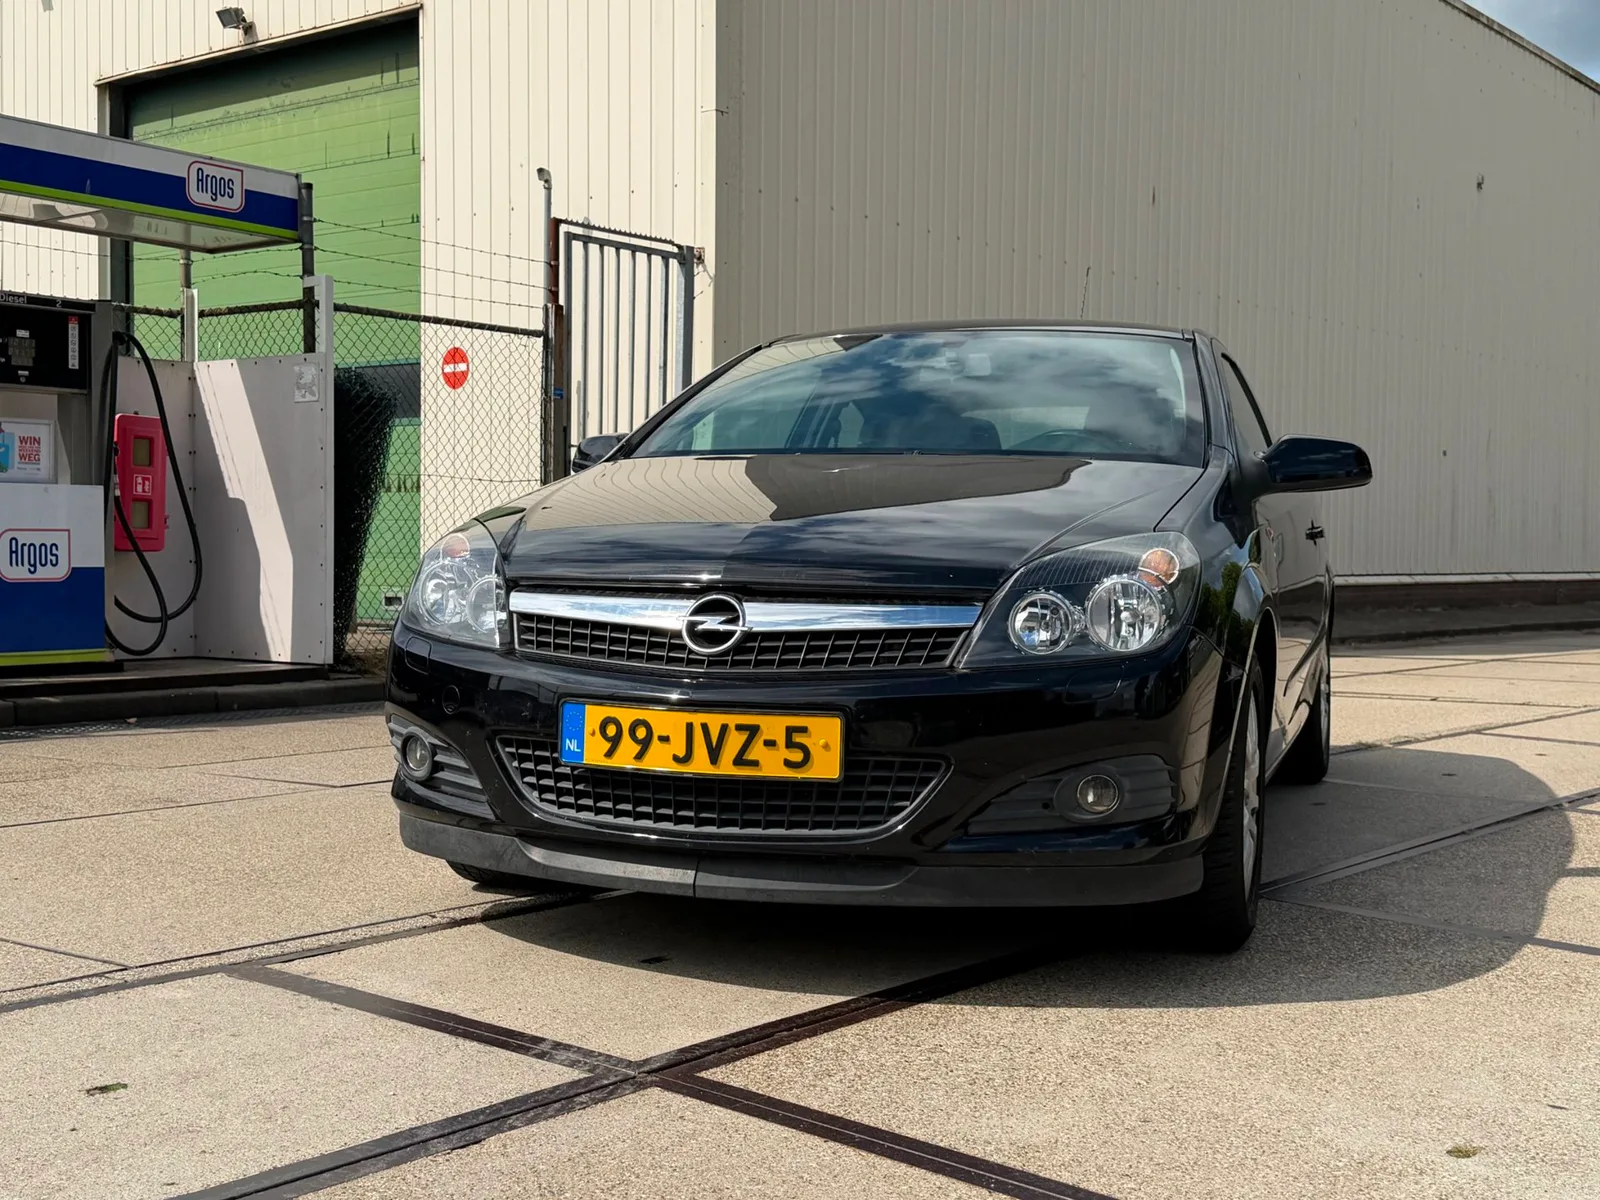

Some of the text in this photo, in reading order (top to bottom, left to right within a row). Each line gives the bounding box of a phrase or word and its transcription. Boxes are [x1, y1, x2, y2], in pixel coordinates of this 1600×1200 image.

[196, 167, 235, 202] Argos
[56, 299, 62, 308] 2
[18, 435, 41, 446] WIN
[18, 453, 41, 462] WEG
[9, 537, 59, 575] Argos
[565, 738, 581, 752] NL
[599, 716, 812, 769] 99-JVZ-5
